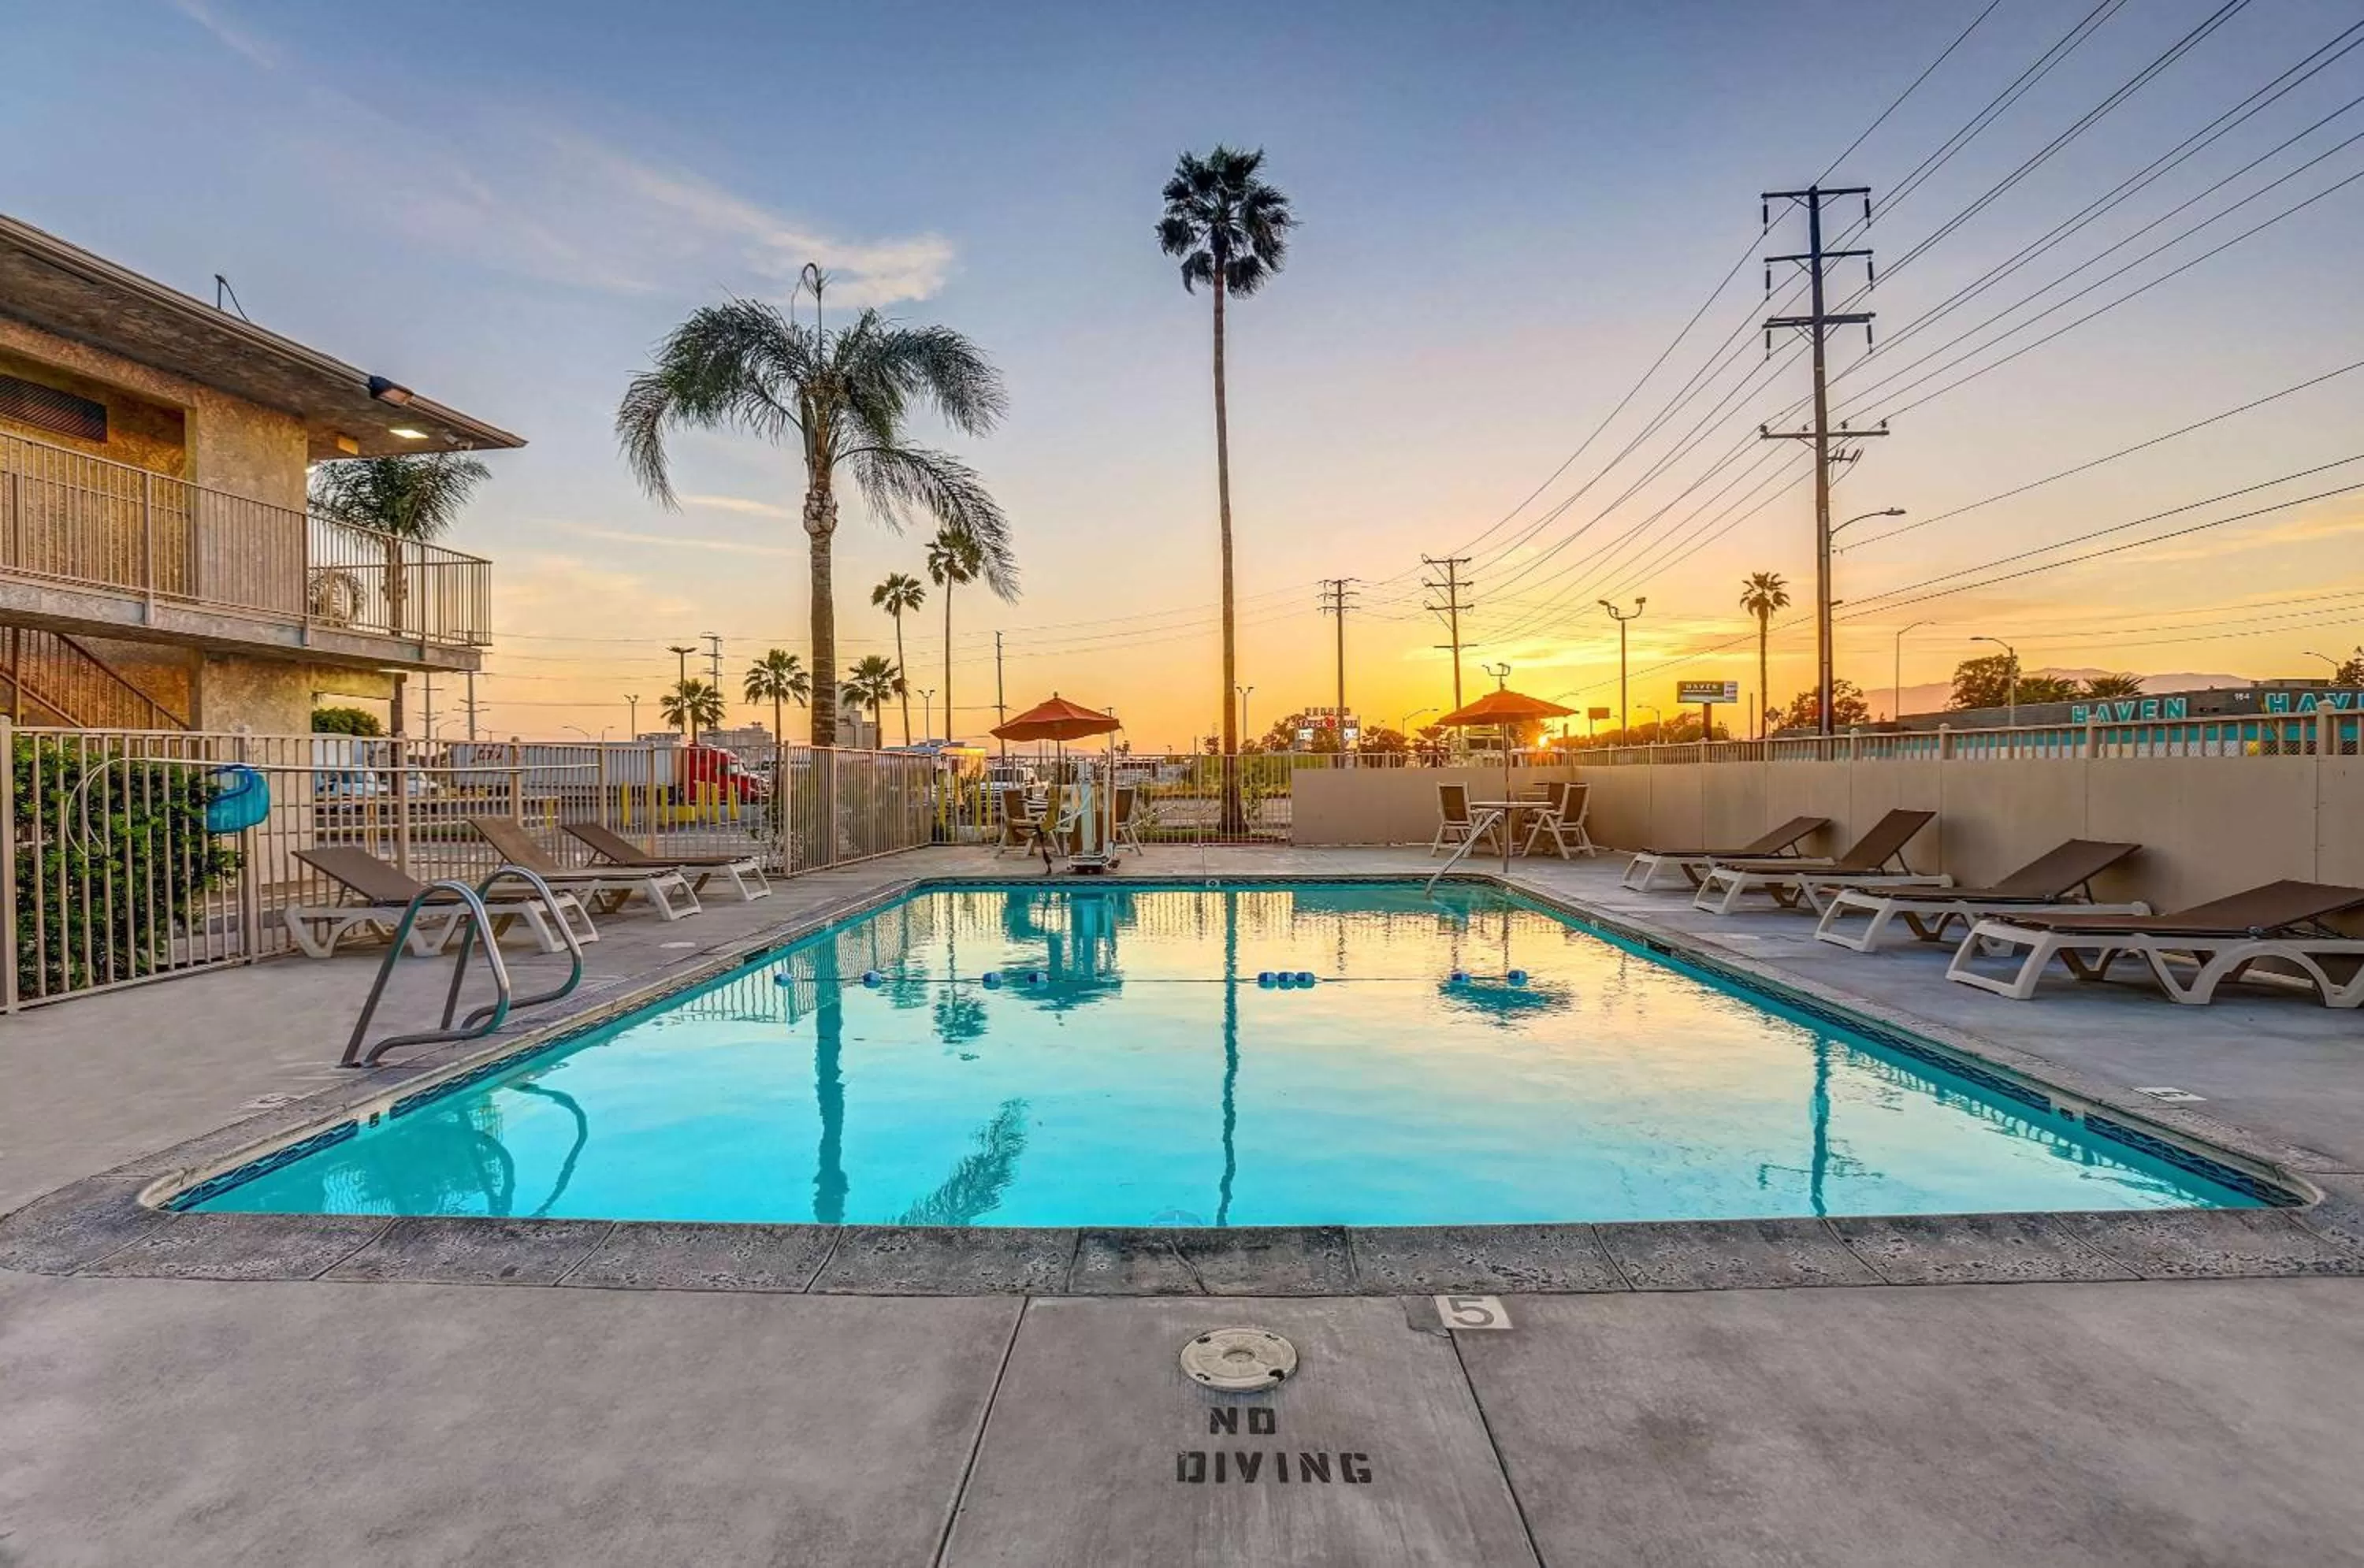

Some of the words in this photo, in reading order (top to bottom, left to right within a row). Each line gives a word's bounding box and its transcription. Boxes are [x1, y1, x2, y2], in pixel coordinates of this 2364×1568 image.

[2072, 697, 2187, 725] HAVEN
[2265, 693, 2364, 714] HAV
[1447, 1296, 1495, 1326] 5
[1210, 1406, 1276, 1435] NO
[1176, 1451, 1373, 1484] DIVING
